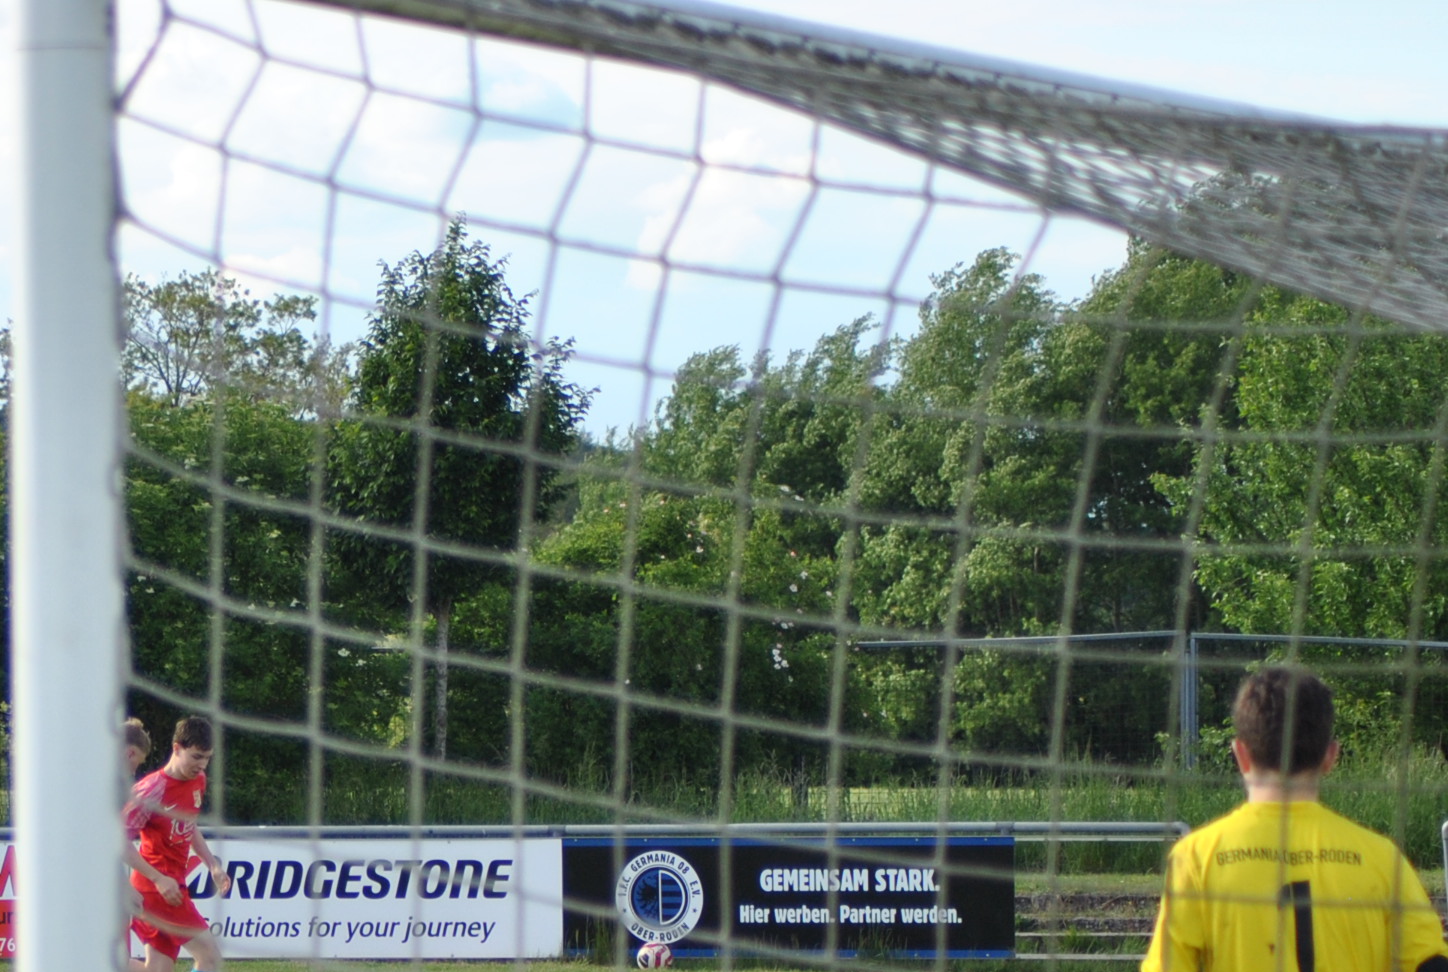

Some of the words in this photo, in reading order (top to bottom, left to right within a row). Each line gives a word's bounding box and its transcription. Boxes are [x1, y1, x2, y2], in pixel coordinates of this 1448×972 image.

[630, 853, 676, 872] GERMANIA
[677, 861, 690, 875] 08
[759, 868, 869, 892] GEMEINSAM
[874, 868, 940, 892] STARK.
[739, 905, 770, 924] Hier
[774, 905, 836, 924] werben.
[839, 905, 896, 924] Partner
[901, 905, 963, 924] werden.
[204, 916, 301, 938] olutions
[308, 917, 342, 937] for
[346, 922, 400, 944] your
[403, 917, 496, 944] journey
